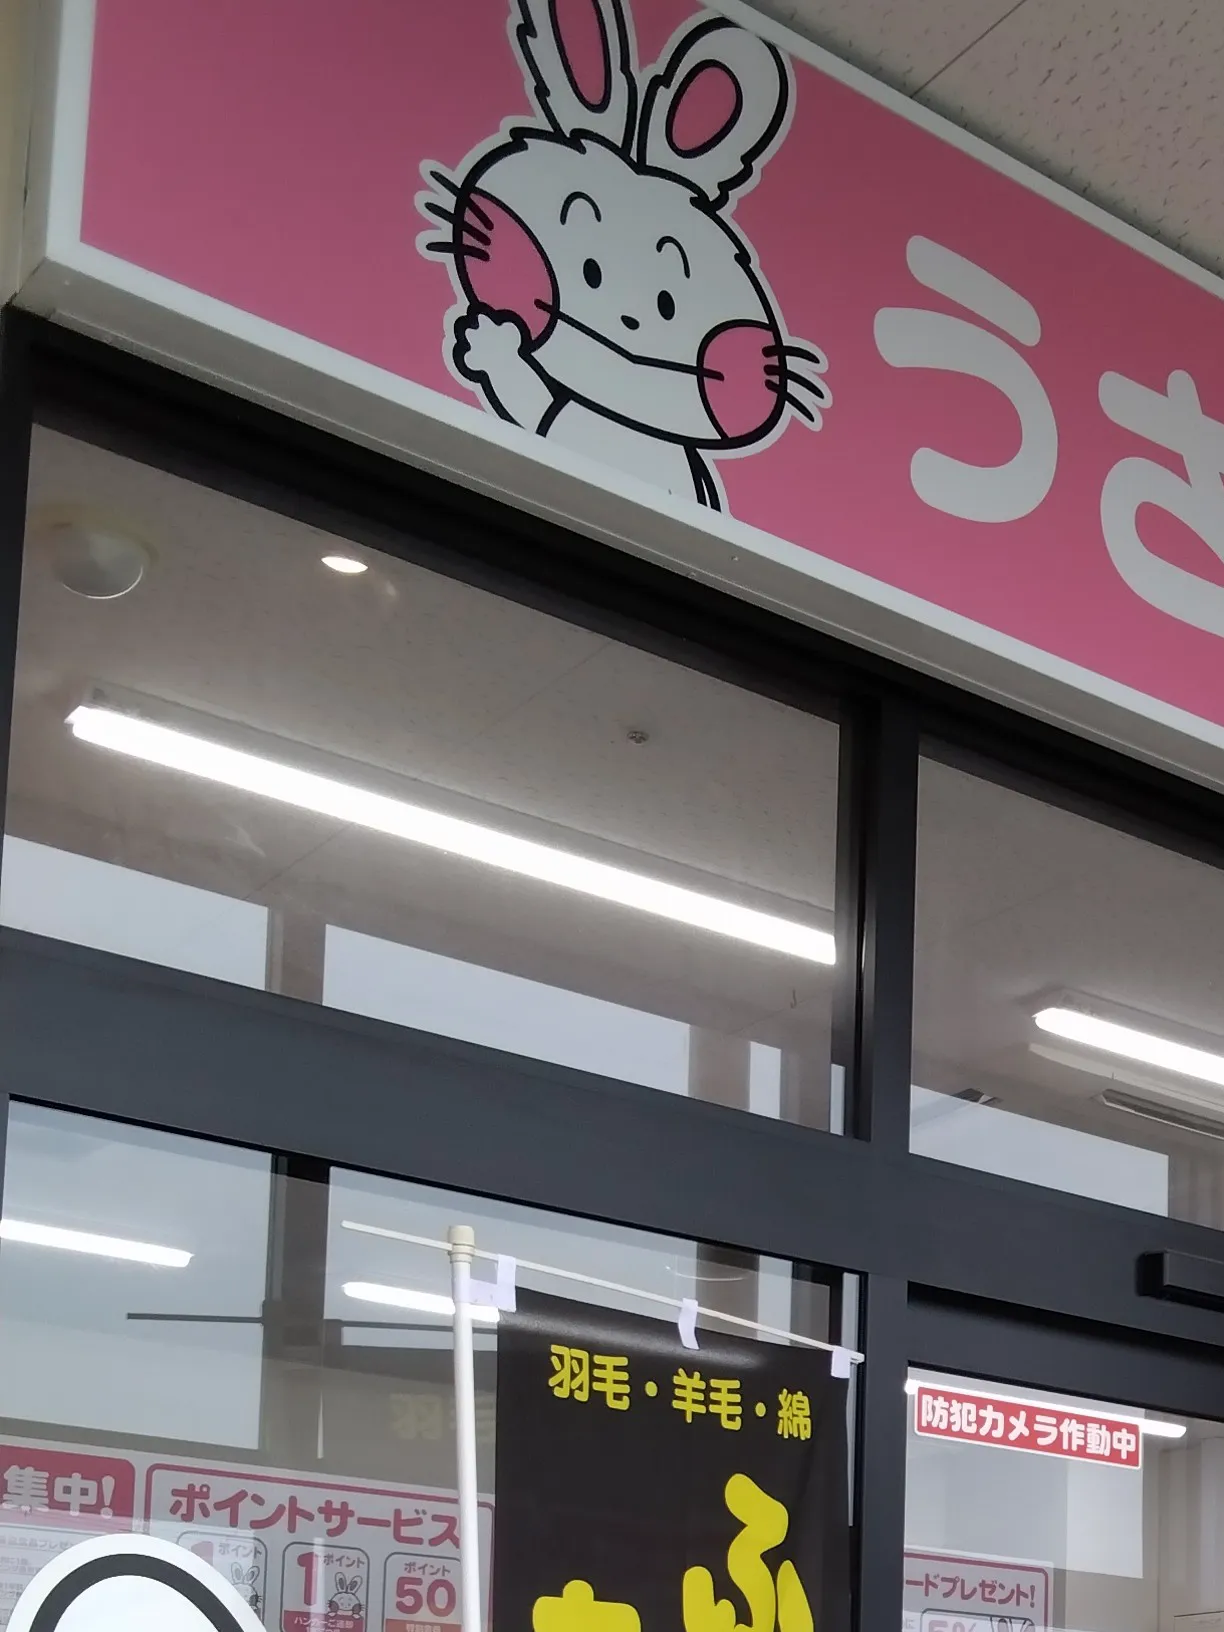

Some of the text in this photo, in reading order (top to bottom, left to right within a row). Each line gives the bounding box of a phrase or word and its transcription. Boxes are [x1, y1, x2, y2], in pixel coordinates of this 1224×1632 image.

[548, 1343, 812, 1441] 羽毛・羊毛・綿
[921, 1394, 1138, 1460] 防犯カメラ作動中
[168, 1482, 461, 1549] ポイントサービス
[395, 1576, 457, 1618] 50
[404, 1561, 451, 1576] ポイント
